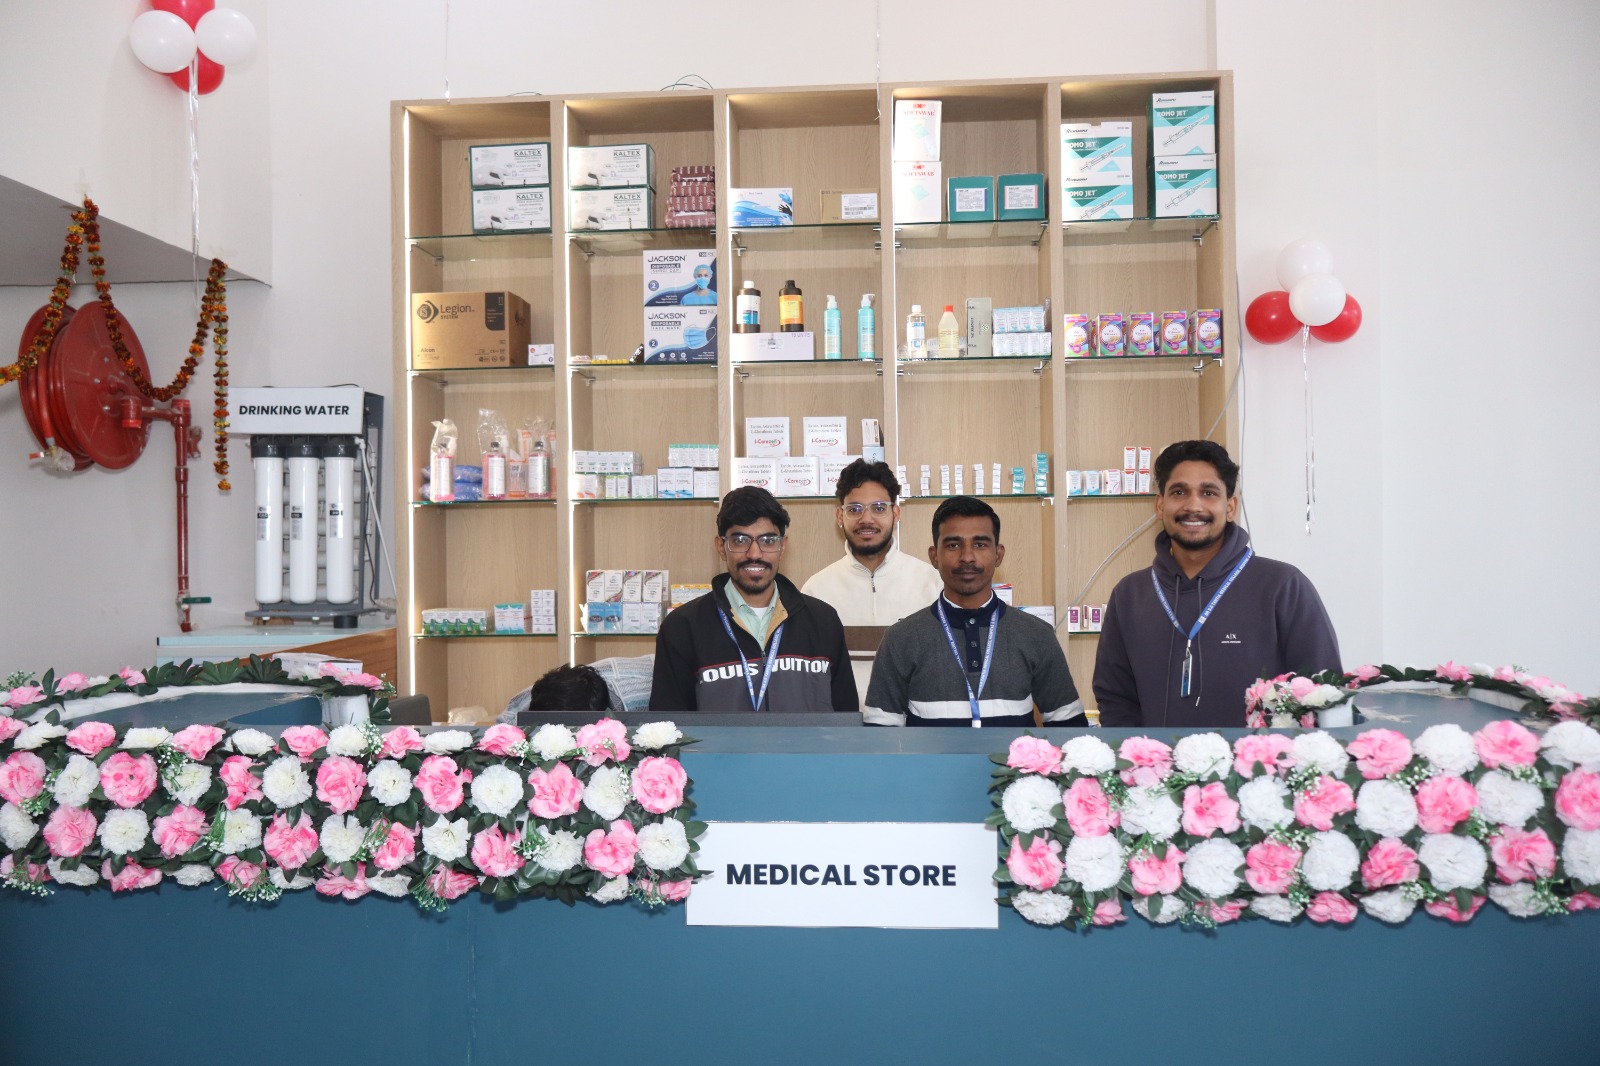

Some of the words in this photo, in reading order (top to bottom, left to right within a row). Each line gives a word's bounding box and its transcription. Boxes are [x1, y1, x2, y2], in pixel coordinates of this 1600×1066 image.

[441, 304, 472, 315] Legion
[239, 405, 302, 416] DRINKING
[304, 405, 350, 416] WATER
[700, 663, 759, 684] OUIS
[726, 863, 857, 885] MEDICAL
[863, 864, 957, 886] STORE
